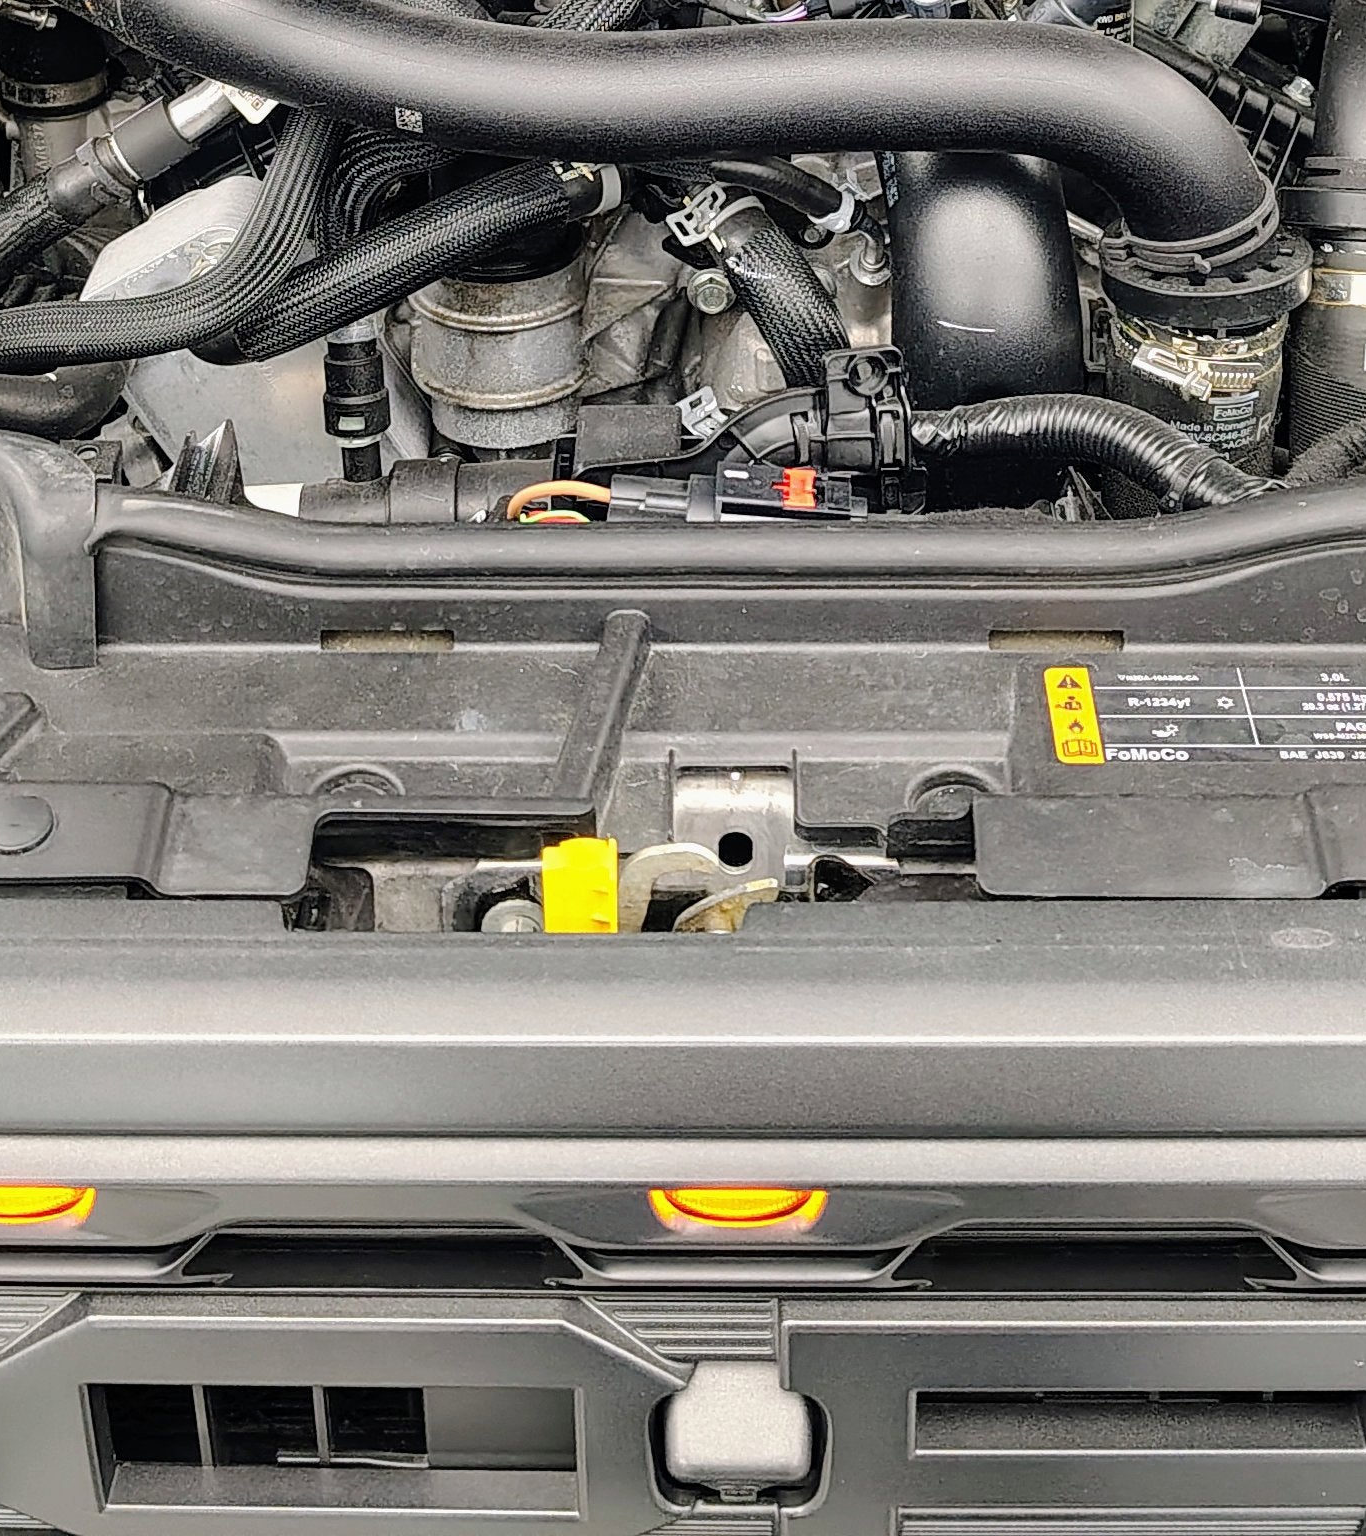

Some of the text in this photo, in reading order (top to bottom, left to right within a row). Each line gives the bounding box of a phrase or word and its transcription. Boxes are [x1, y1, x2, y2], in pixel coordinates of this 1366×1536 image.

[1203, 421, 1214, 432] in
[1319, 672, 1350, 683] 3.0L
[1127, 696, 1192, 709] R-1234yf
[1105, 748, 1190, 761] FoMoCo
[1279, 750, 1309, 760] SAE
